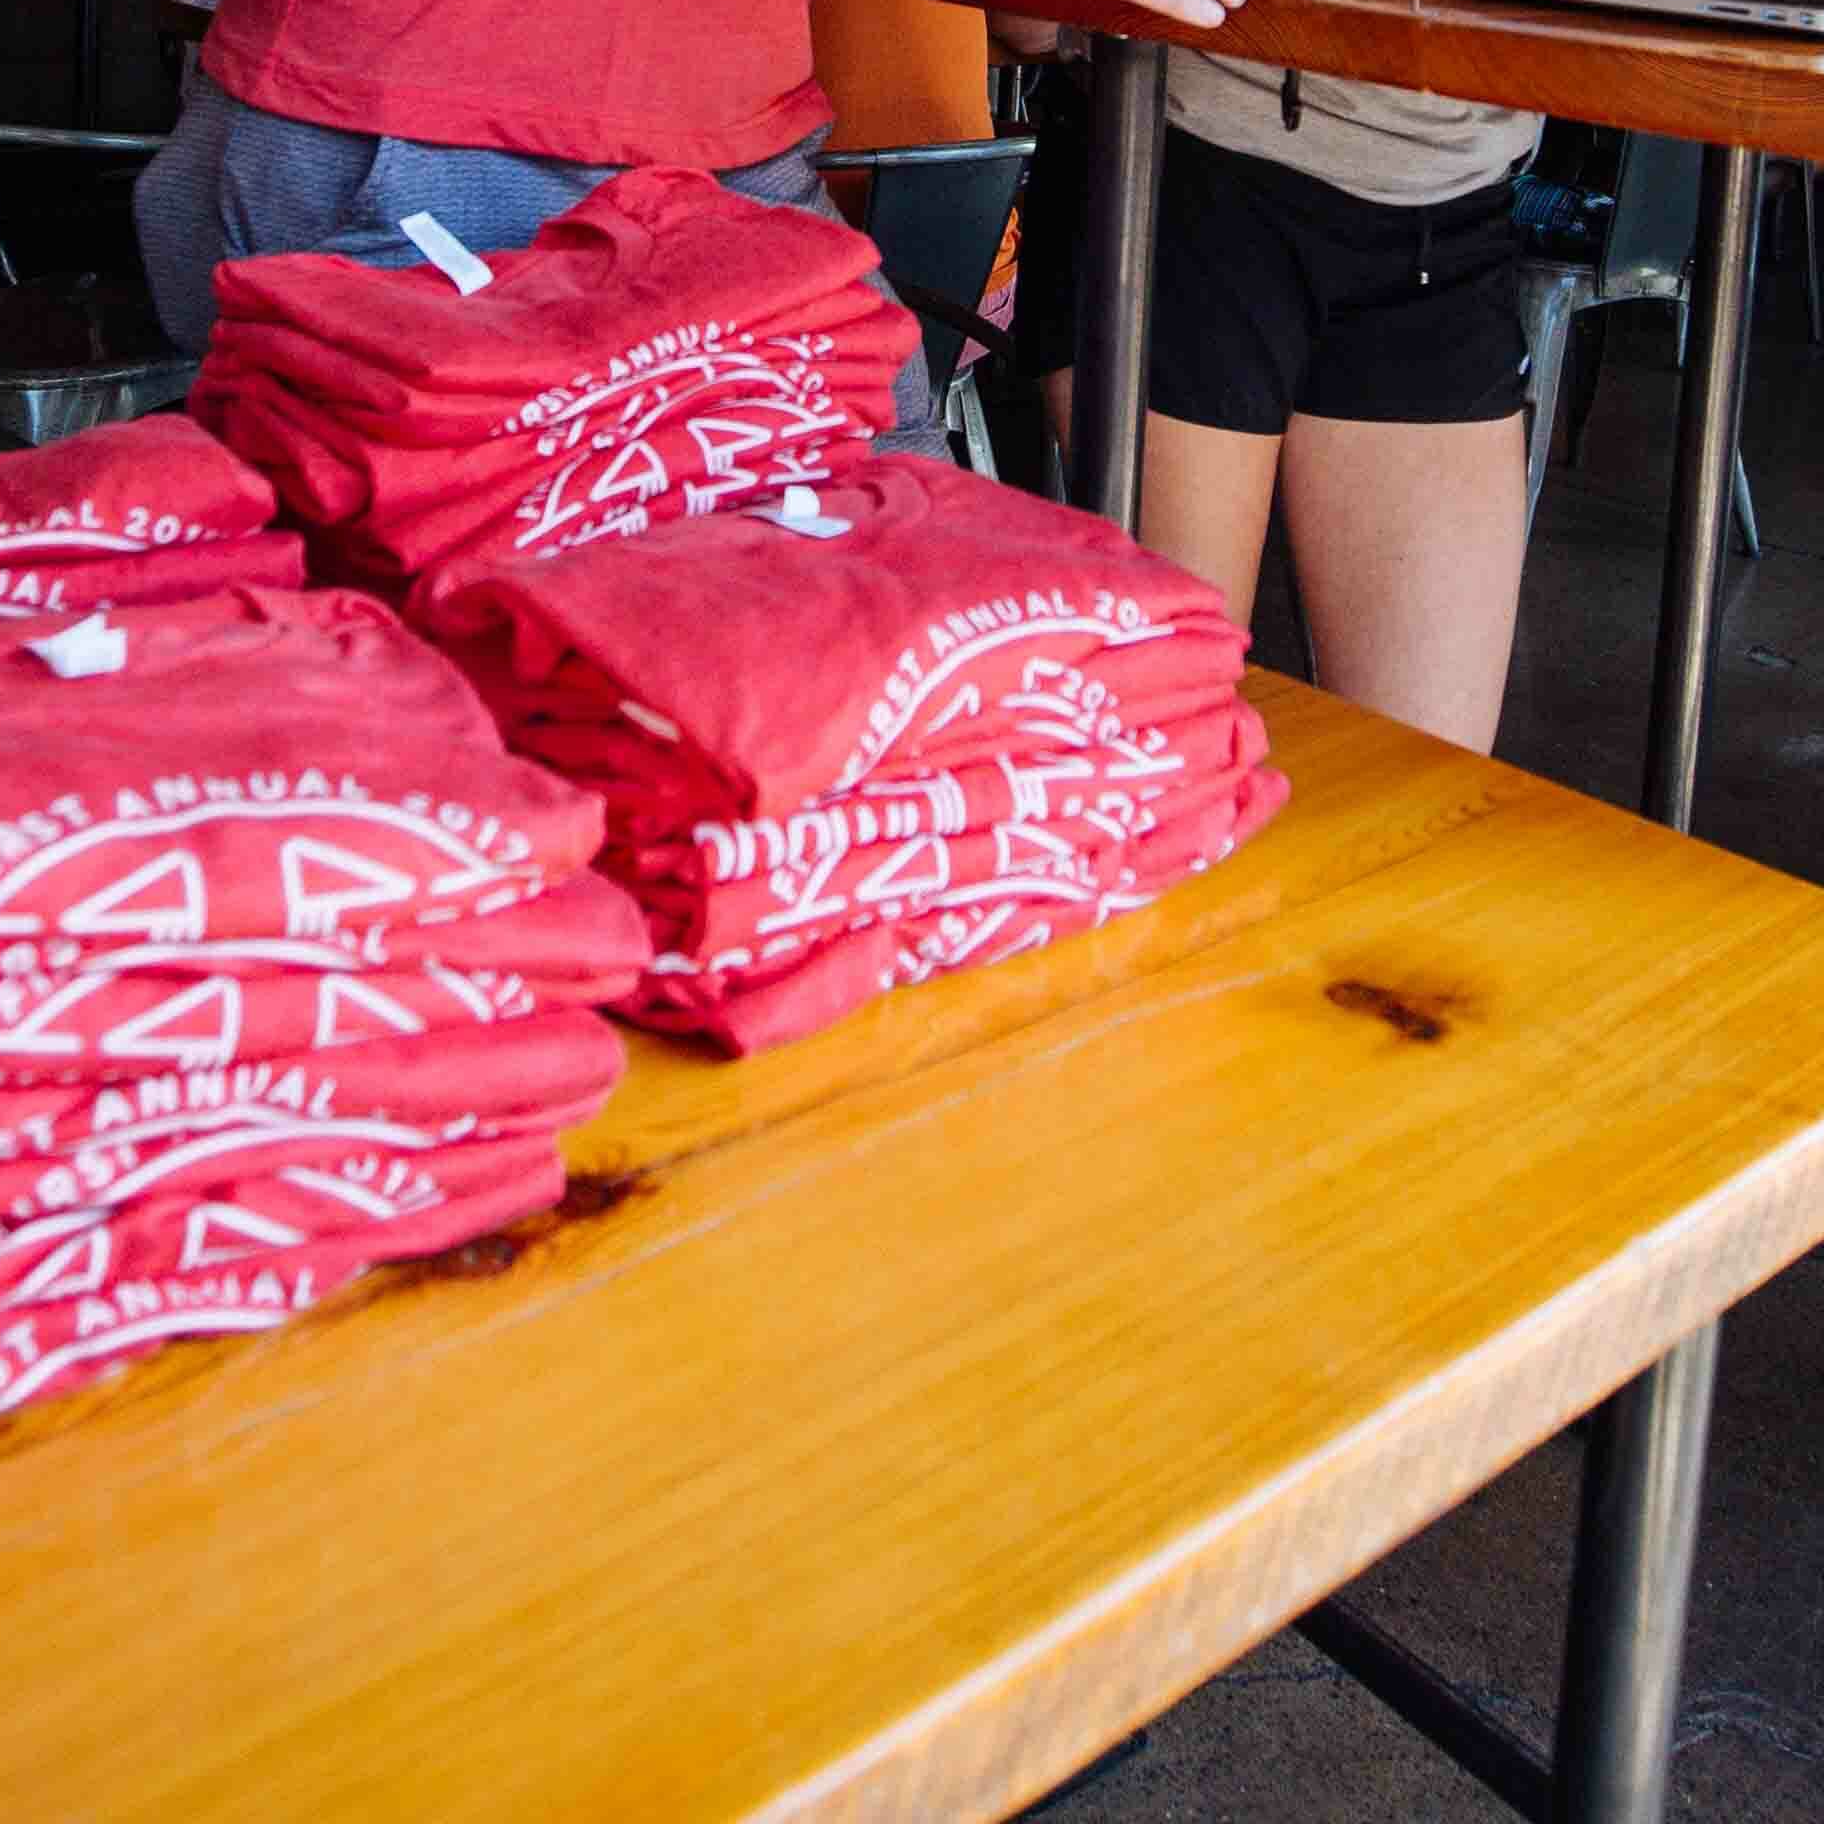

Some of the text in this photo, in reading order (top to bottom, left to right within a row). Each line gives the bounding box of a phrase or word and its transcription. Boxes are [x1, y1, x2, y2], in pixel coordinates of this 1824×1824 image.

[926, 588, 1076, 660] ANNUAL
[115, 768, 370, 821] ANNUAL
[401, 792, 531, 864] 2017
[92, 1063, 339, 1131] ANNUAL
